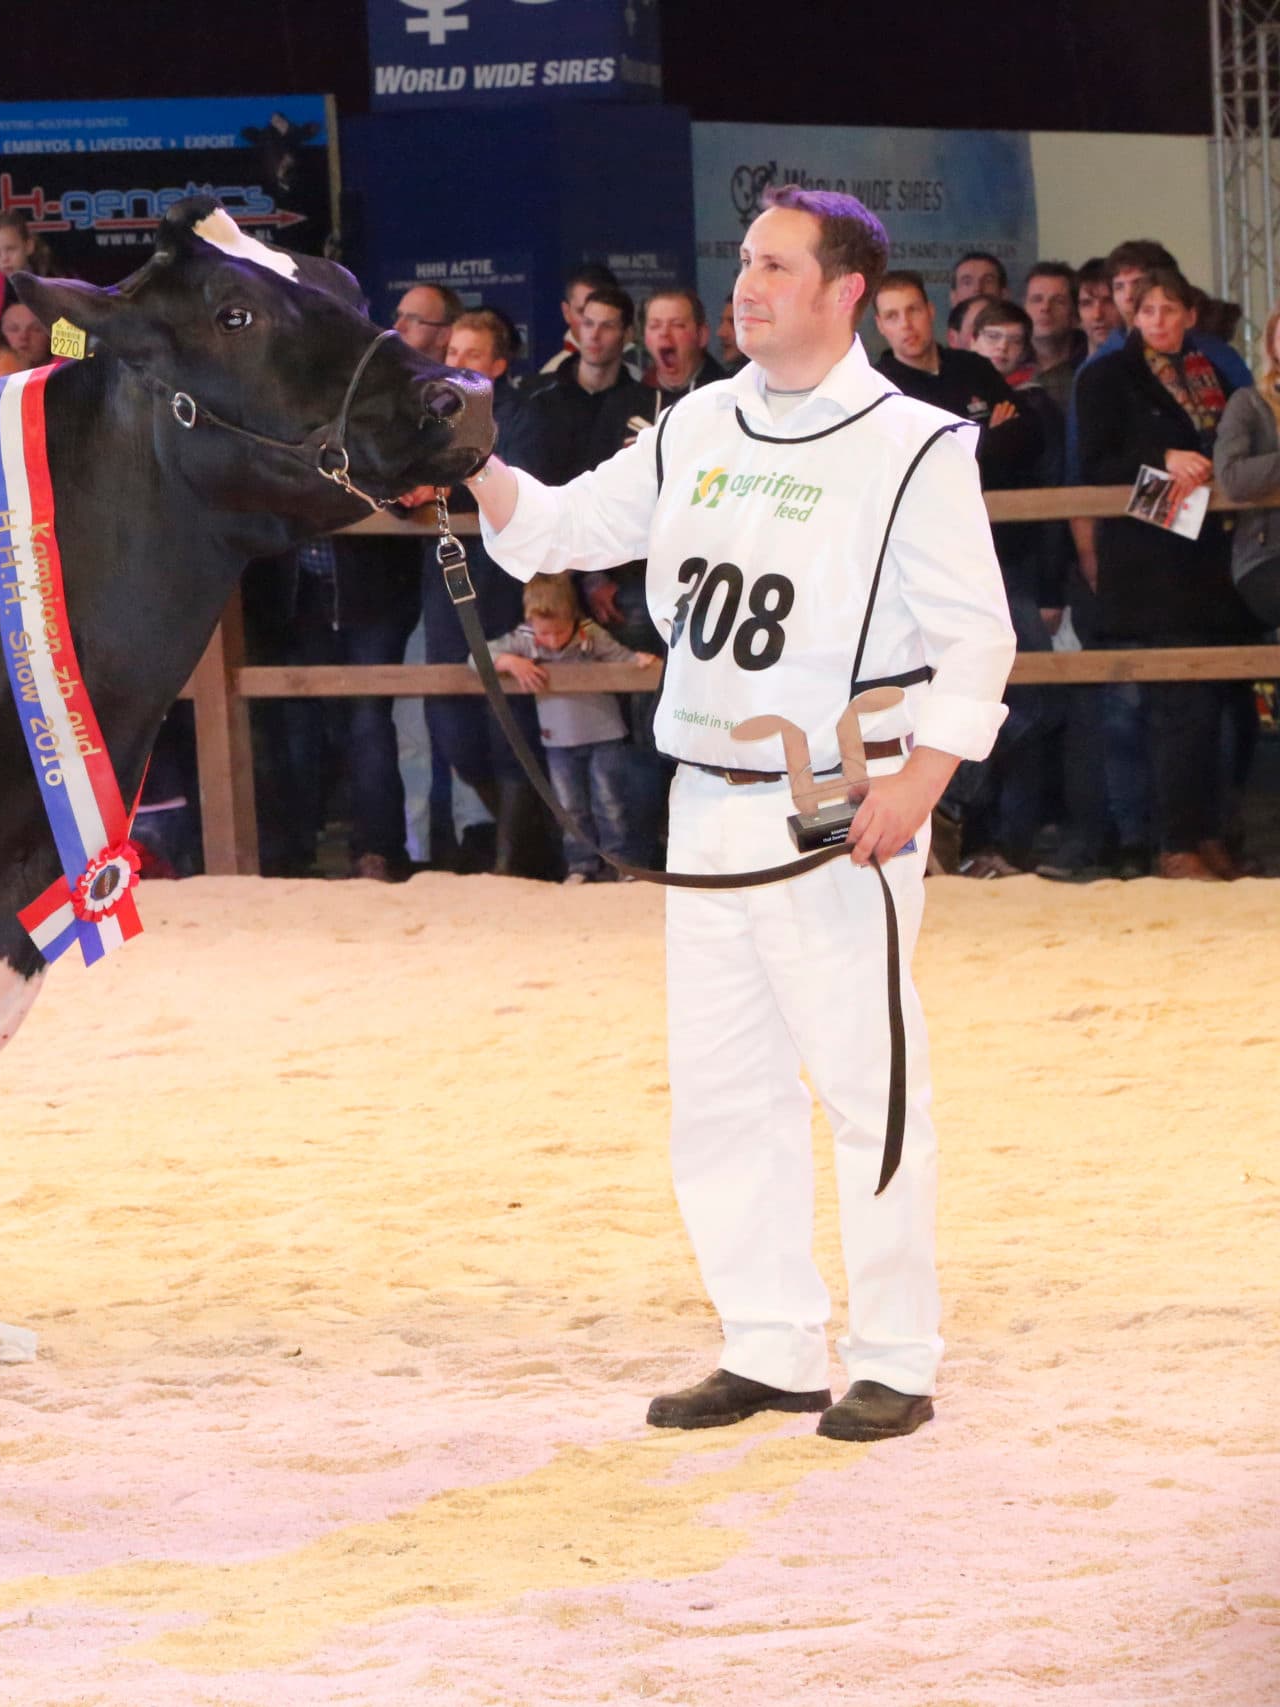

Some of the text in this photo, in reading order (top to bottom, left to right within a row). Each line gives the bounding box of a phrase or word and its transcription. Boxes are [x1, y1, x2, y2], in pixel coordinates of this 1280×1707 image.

[375, 65, 466, 94] WORLD
[473, 62, 537, 89] WIDE
[541, 57, 615, 85] SIRES
[3, 139, 71, 155] EMBRYOS
[75, 138, 85, 153] &
[89, 136, 162, 152] LIVESTOCK
[184, 134, 237, 149] EXPORT
[898, 179, 944, 212] SIRES
[416, 262, 447, 278] HHH
[52, 336, 80, 357] 9270
[730, 471, 822, 504] agrifirm
[774, 502, 814, 522] feed
[30, 522, 63, 655] Kampioen
[67, 711, 102, 757] oud
[9, 631, 40, 703] Show
[30, 715, 64, 786] 2016
[673, 707, 709, 727] schakel
[710, 715, 721, 729] in
